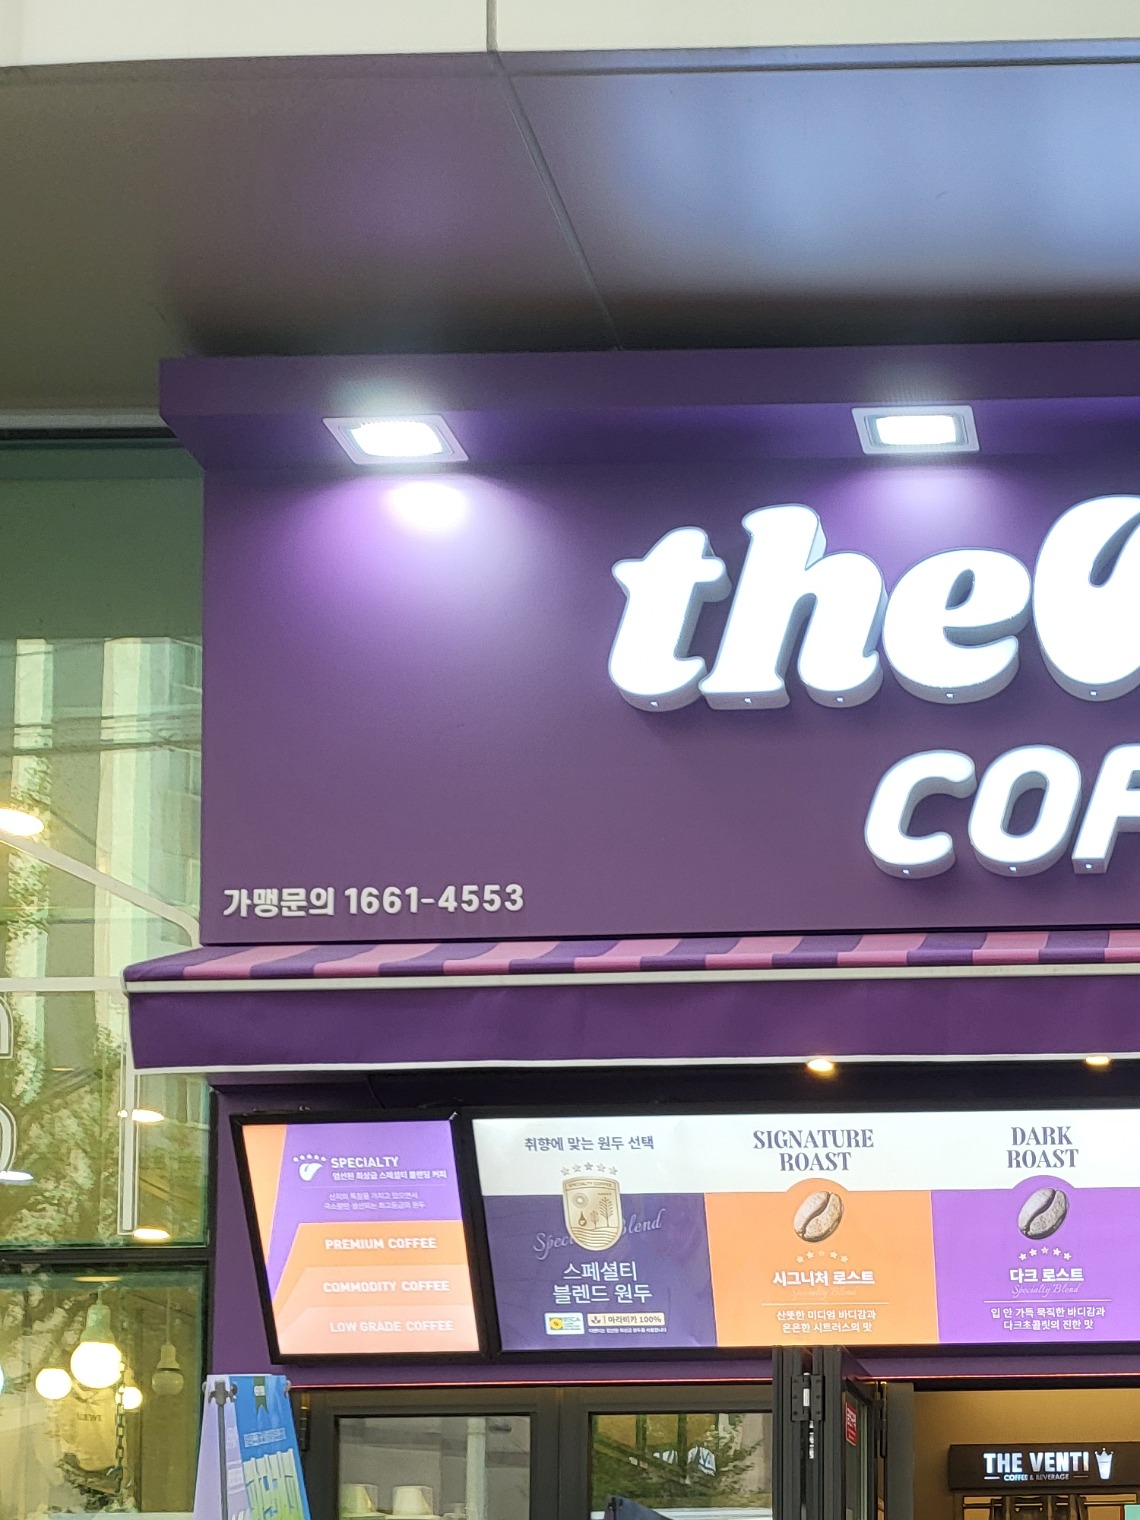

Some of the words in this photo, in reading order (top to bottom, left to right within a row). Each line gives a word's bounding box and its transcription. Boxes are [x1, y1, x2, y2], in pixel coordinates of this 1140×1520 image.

[223, 886, 335, 918] 가맹문의
[344, 884, 524, 914] 1661-4553
[525, 1137, 564, 1152] 취향에
[568, 1136, 594, 1151] 맞는
[597, 1136, 624, 1150] 원두
[628, 1136, 654, 1150] 선택
[752, 1129, 874, 1149] SIGNATURE
[1011, 1126, 1073, 1146] DARK
[331, 1156, 399, 1168] SPECIALTY
[779, 1152, 851, 1172] ROAST
[1006, 1149, 1079, 1168] ROAST
[325, 1238, 384, 1250] PREMIUM
[388, 1237, 437, 1249] COFFEE
[563, 1261, 636, 1282] 스페셜티
[772, 1270, 829, 1287] 시그니처
[832, 1270, 876, 1286] 로스트
[1009, 1268, 1039, 1284] 다크
[1041, 1268, 1085, 1282] 로스트
[323, 1281, 396, 1293] COMMODITY
[401, 1280, 450, 1292] COFFEE
[552, 1285, 610, 1305] 블렌드
[614, 1284, 653, 1304] 원두
[639, 1315, 662, 1323] 100%
[990, 1307, 1001, 1319] 입
[1002, 1307, 1013, 1318] 안
[1015, 1307, 1034, 1318] 가득
[1067, 1306, 1106, 1317] 바디감과
[329, 1322, 358, 1333] LOW
[360, 1321, 402, 1332] GRADE
[405, 1320, 454, 1332] COFFEE
[1084, 1319, 1094, 1330] 맛
[983, 1452, 1023, 1474] THE
[1029, 1451, 1090, 1472] VENTI
[1003, 1474, 1029, 1482] COFFEE
[1035, 1473, 1069, 1481] BEVERAGE
